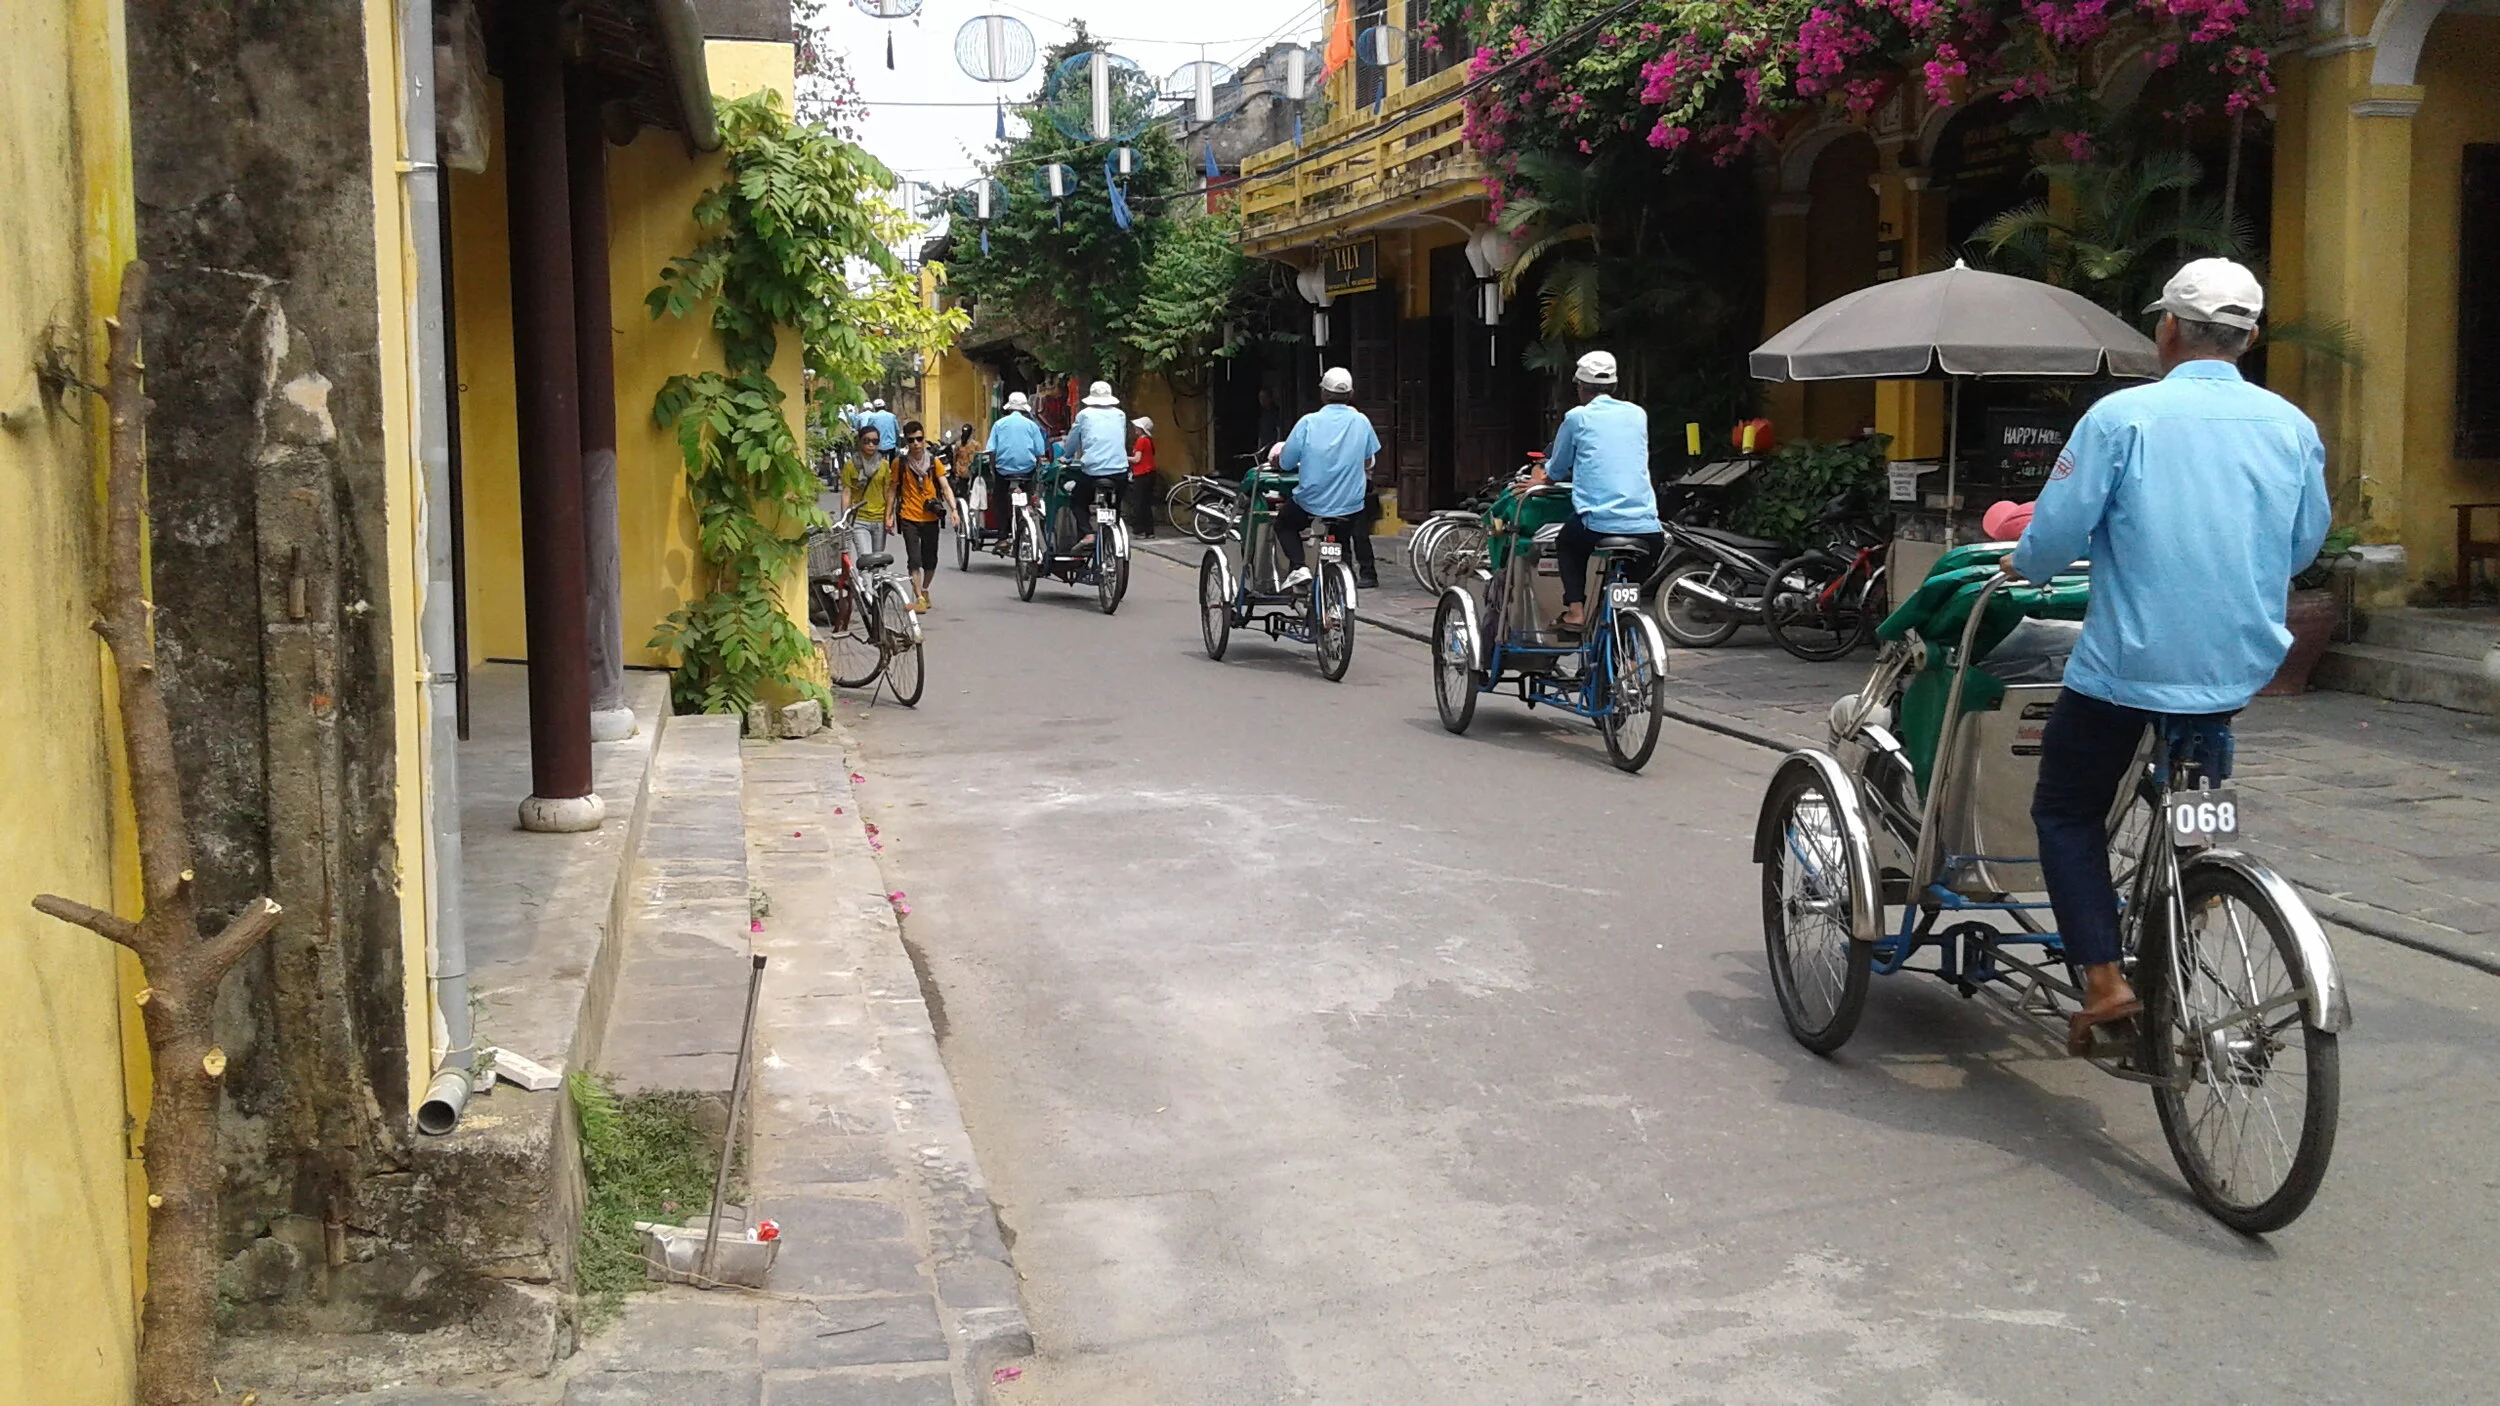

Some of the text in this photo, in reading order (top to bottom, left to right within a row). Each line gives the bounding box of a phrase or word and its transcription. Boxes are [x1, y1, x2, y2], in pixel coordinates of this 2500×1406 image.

[2003, 426, 2037, 444] HAPPY
[1613, 588, 1638, 602] 095
[2176, 801, 2236, 833] 068
